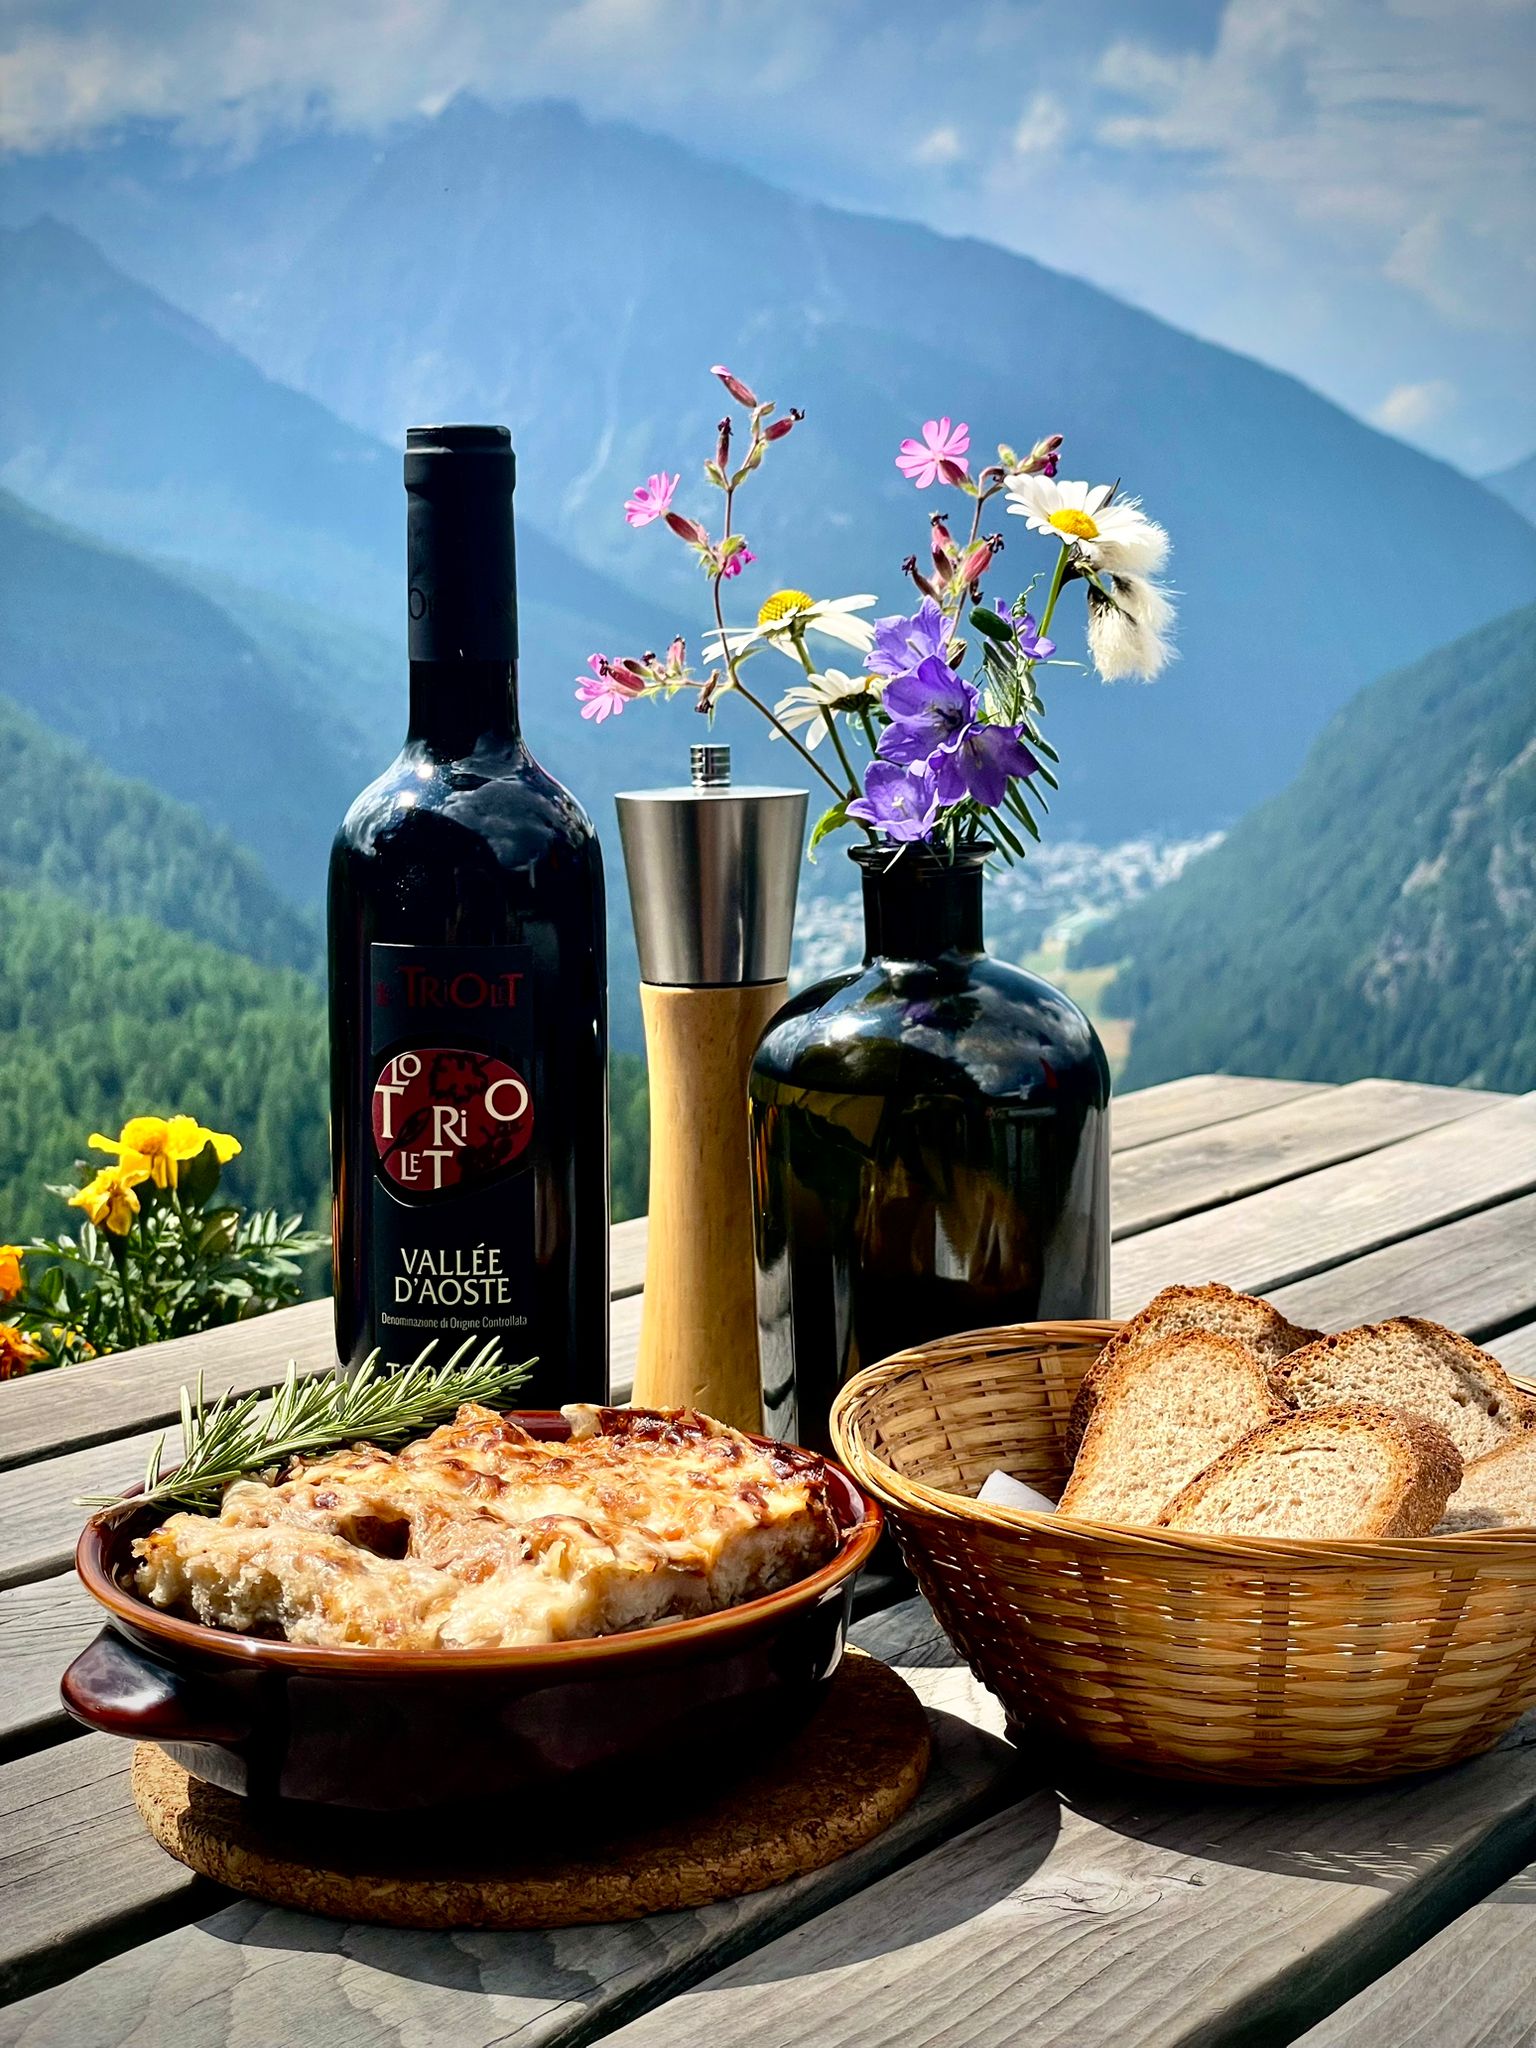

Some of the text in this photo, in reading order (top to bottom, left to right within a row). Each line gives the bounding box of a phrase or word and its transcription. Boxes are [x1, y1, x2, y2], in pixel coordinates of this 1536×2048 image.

[400, 1243, 503, 1276] VALLÉE
[394, 1276, 512, 1306] D'AOSTE
[381, 1312, 528, 1331] Denominazione di Origine Controllata
